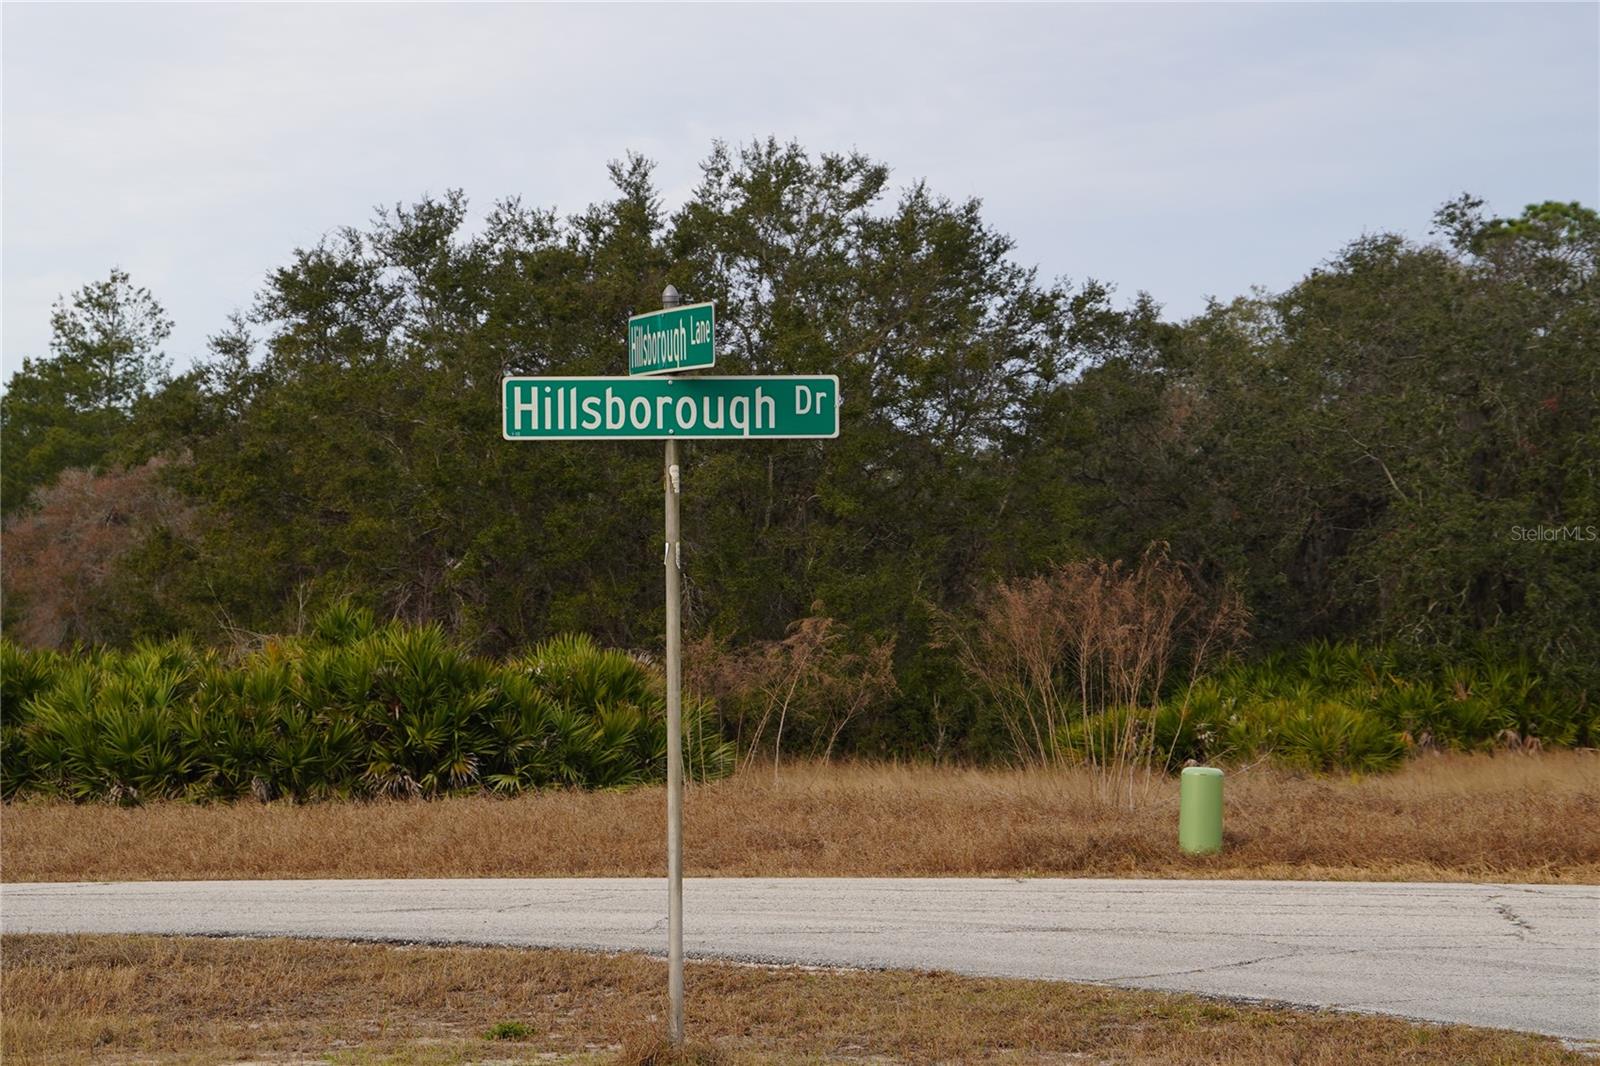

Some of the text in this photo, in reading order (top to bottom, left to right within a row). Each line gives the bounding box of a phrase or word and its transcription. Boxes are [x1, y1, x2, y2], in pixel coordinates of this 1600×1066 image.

[631, 316, 711, 368] Hillsborough Lane
[513, 385, 827, 436] Hillsborough Dr
